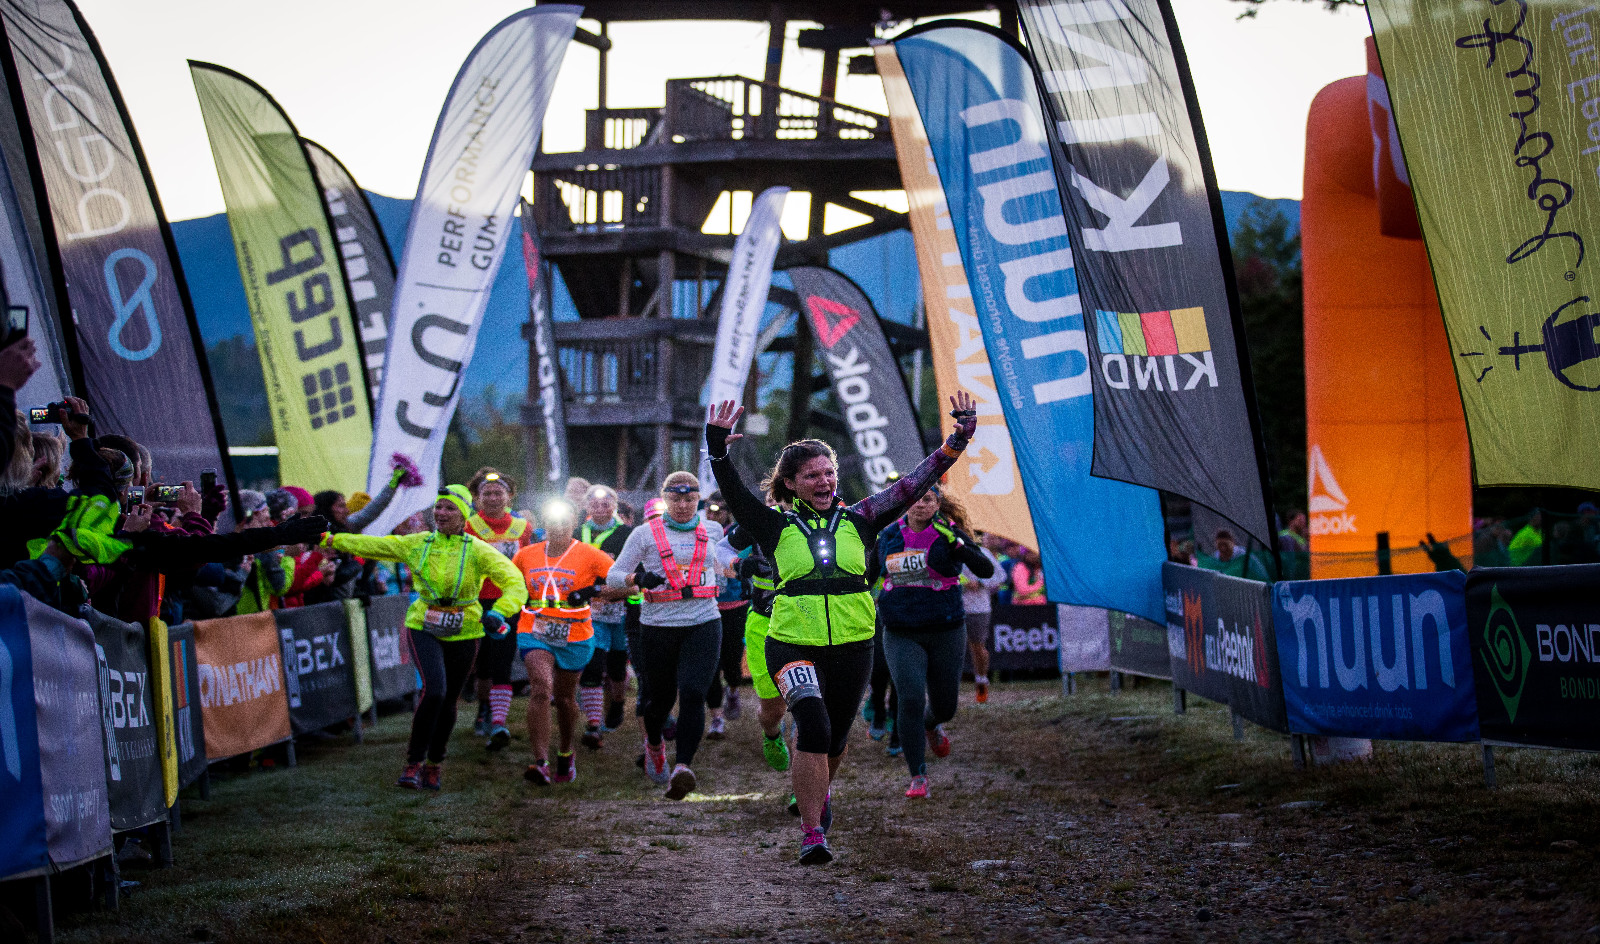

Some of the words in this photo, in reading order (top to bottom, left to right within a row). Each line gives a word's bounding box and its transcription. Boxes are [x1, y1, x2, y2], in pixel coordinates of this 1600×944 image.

[438, 76, 500, 268] PERFORMANCE
[472, 214, 497, 271] GUM
[902, 555, 924, 571] 461
[994, 622, 1058, 652] Reeb
[1217, 617, 1258, 684] Reebok
[1271, 582, 1456, 692] nuun
[788, 666, 814, 688] 161
